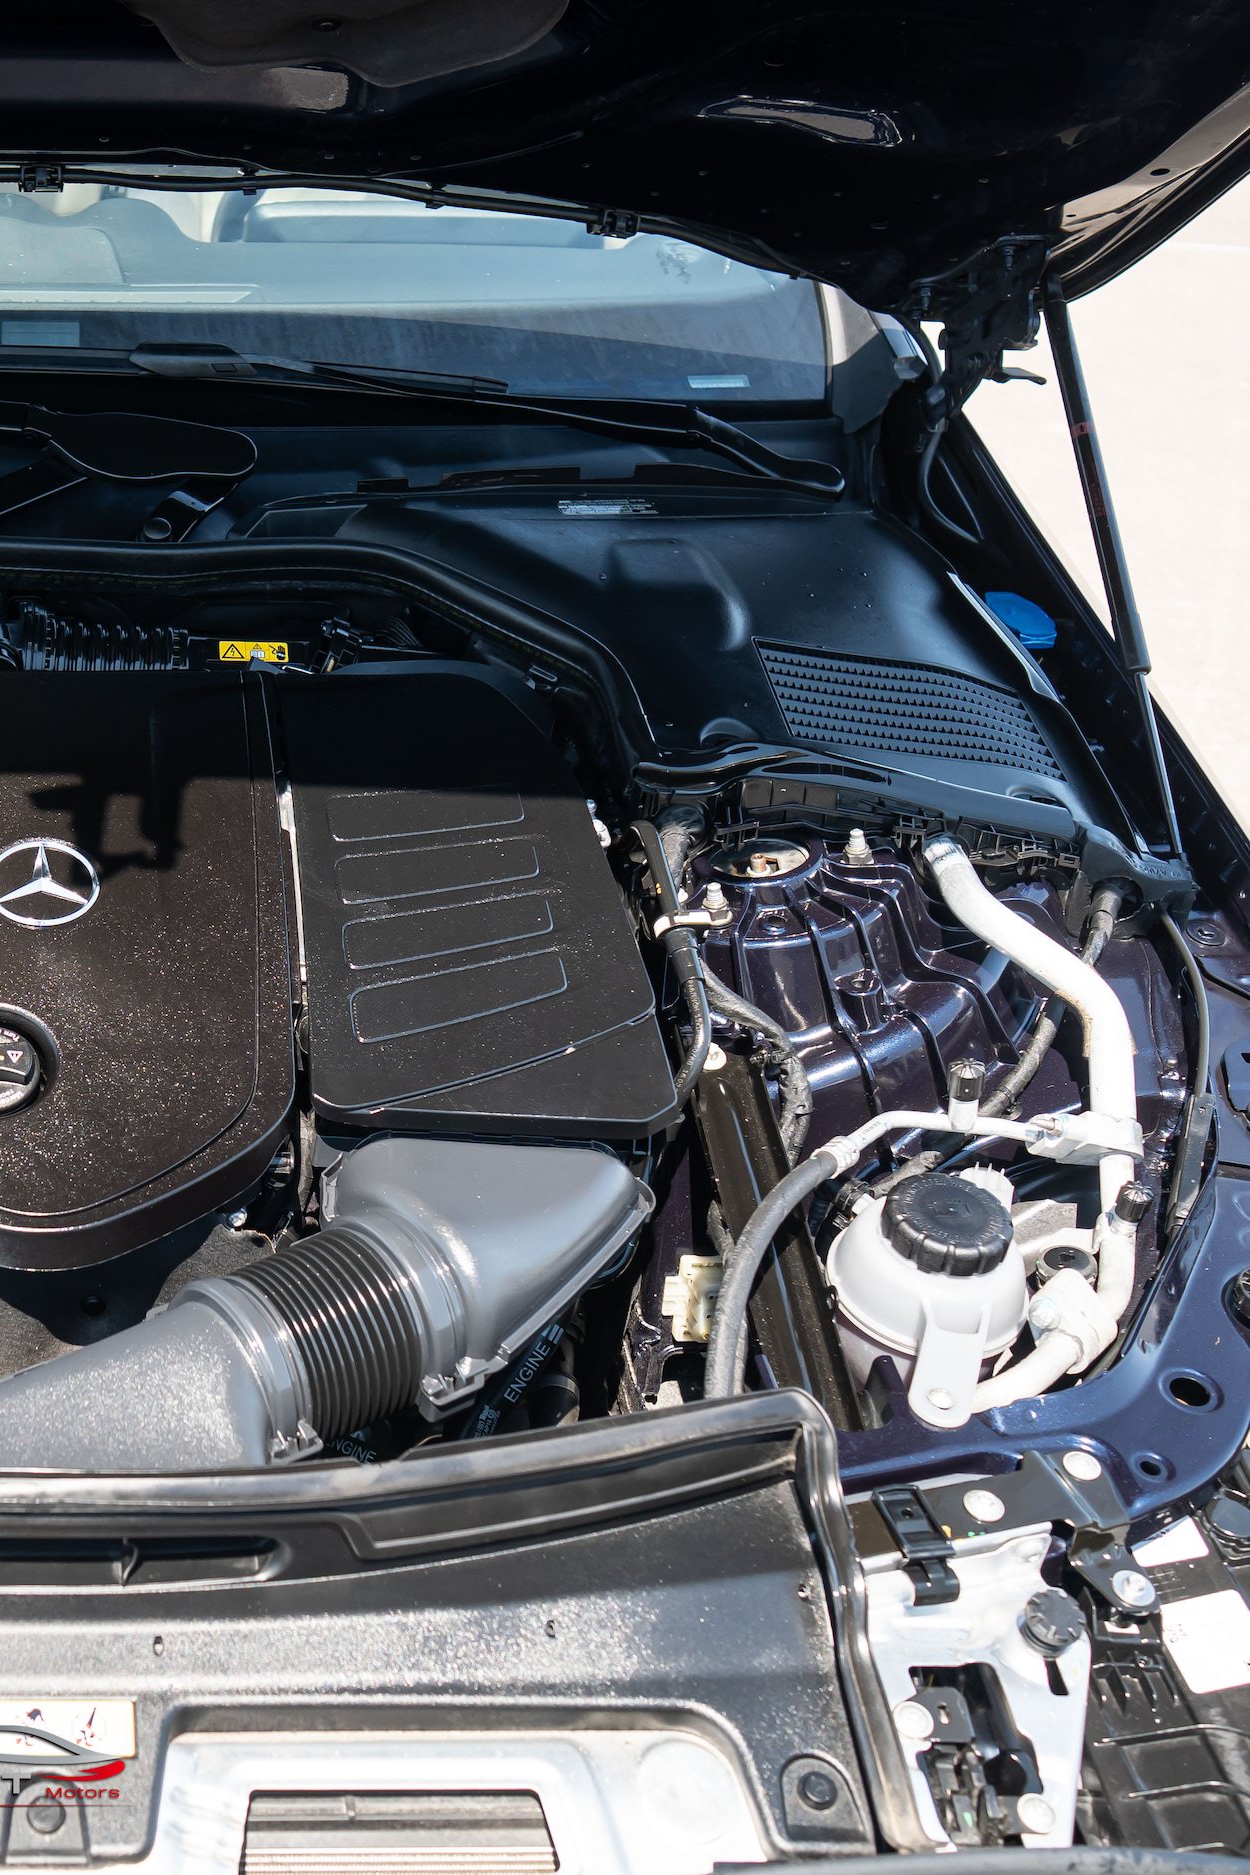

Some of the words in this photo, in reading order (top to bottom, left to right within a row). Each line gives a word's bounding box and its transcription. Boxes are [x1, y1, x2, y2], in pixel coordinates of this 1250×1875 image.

[3, 1029, 20, 1042] Turn
[503, 1341, 551, 1403] ENGINE
[328, 1439, 377, 1464] NGINE
